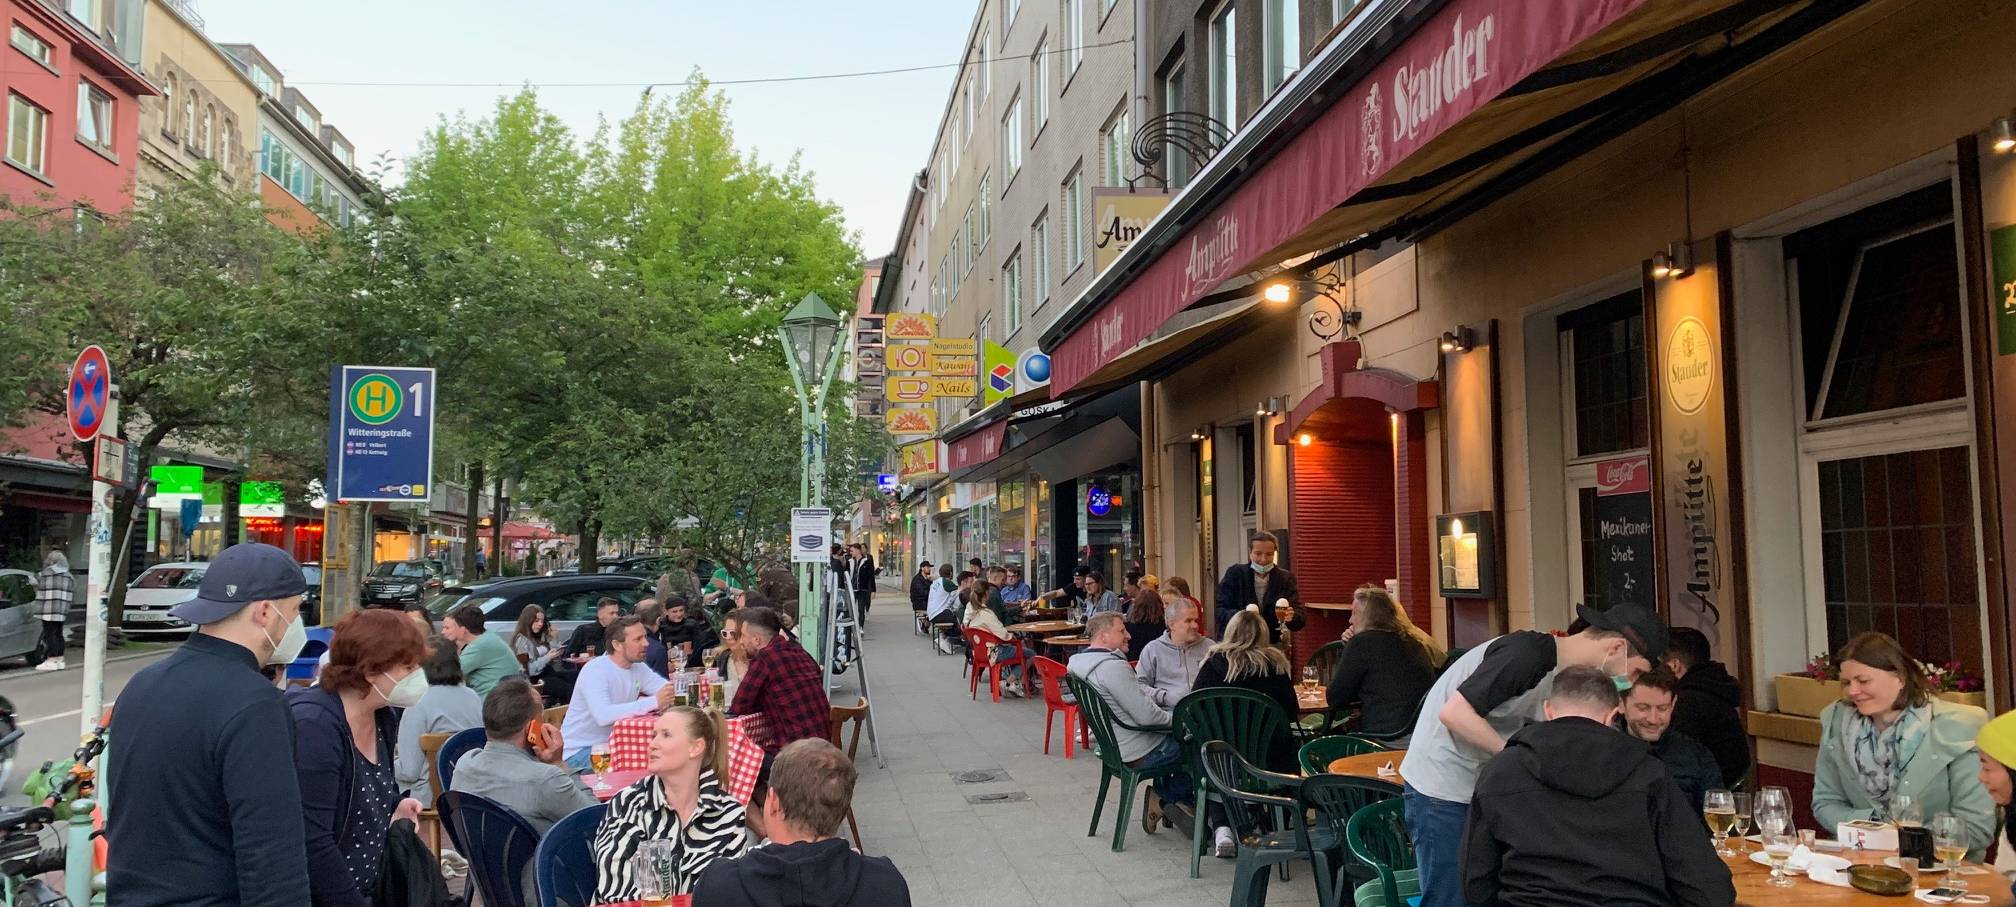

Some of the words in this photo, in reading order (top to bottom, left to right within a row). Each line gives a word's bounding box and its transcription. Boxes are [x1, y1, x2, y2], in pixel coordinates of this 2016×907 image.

[1393, 11, 1495, 143] Stauder
[933, 343, 974, 351] Nagelstudio
[1671, 359, 1708, 385] Stauder
[365, 385, 388, 412] H
[408, 382, 424, 417] 1
[936, 382, 971, 395] Nails
[348, 428, 412, 438] Witteringstraße
[1601, 517, 1651, 539] Mexikaner
[1684, 457, 1721, 625] Ampütte
[1611, 545, 1634, 561] Shot
